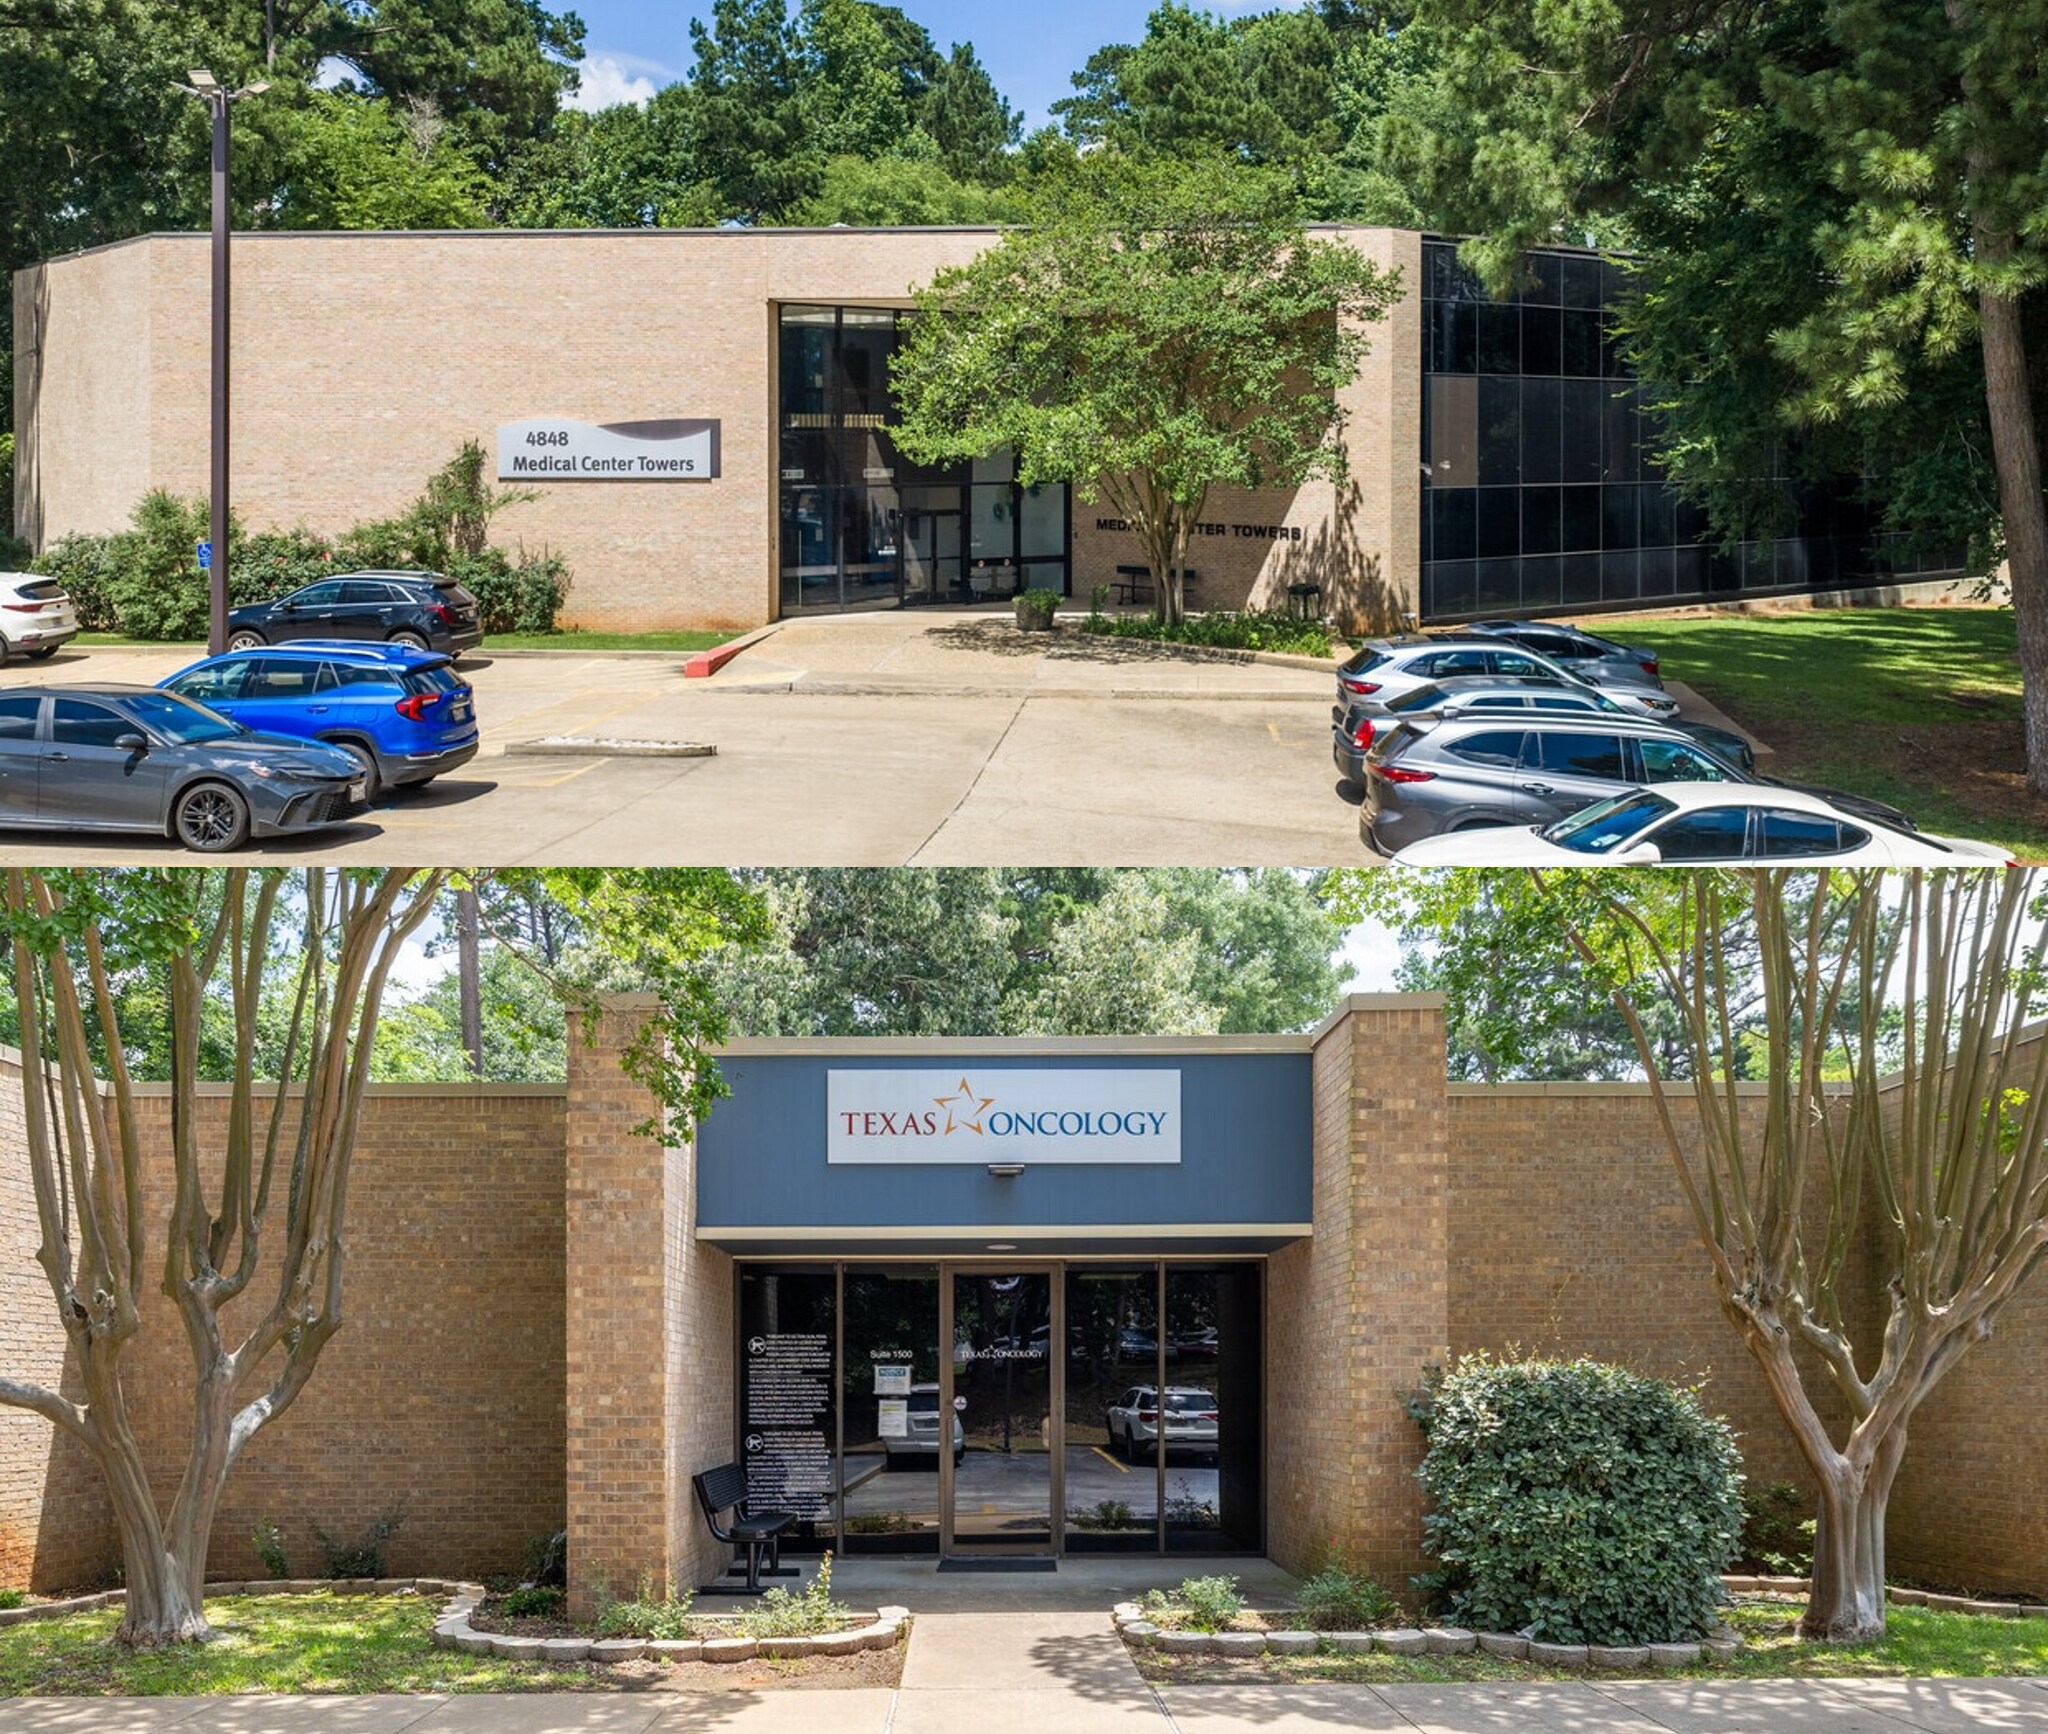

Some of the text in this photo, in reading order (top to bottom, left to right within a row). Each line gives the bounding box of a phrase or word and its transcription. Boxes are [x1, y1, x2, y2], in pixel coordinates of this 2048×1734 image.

[526, 431, 569, 447] 4848
[513, 455, 695, 471] Medical Center Towers
[1231, 525, 1302, 541] TOWERS
[840, 1111, 1167, 1136] TEXAS ONCOLOGY
[893, 1349, 913, 1359] 1500
[997, 1350, 1043, 1359] ONCOLOGY
